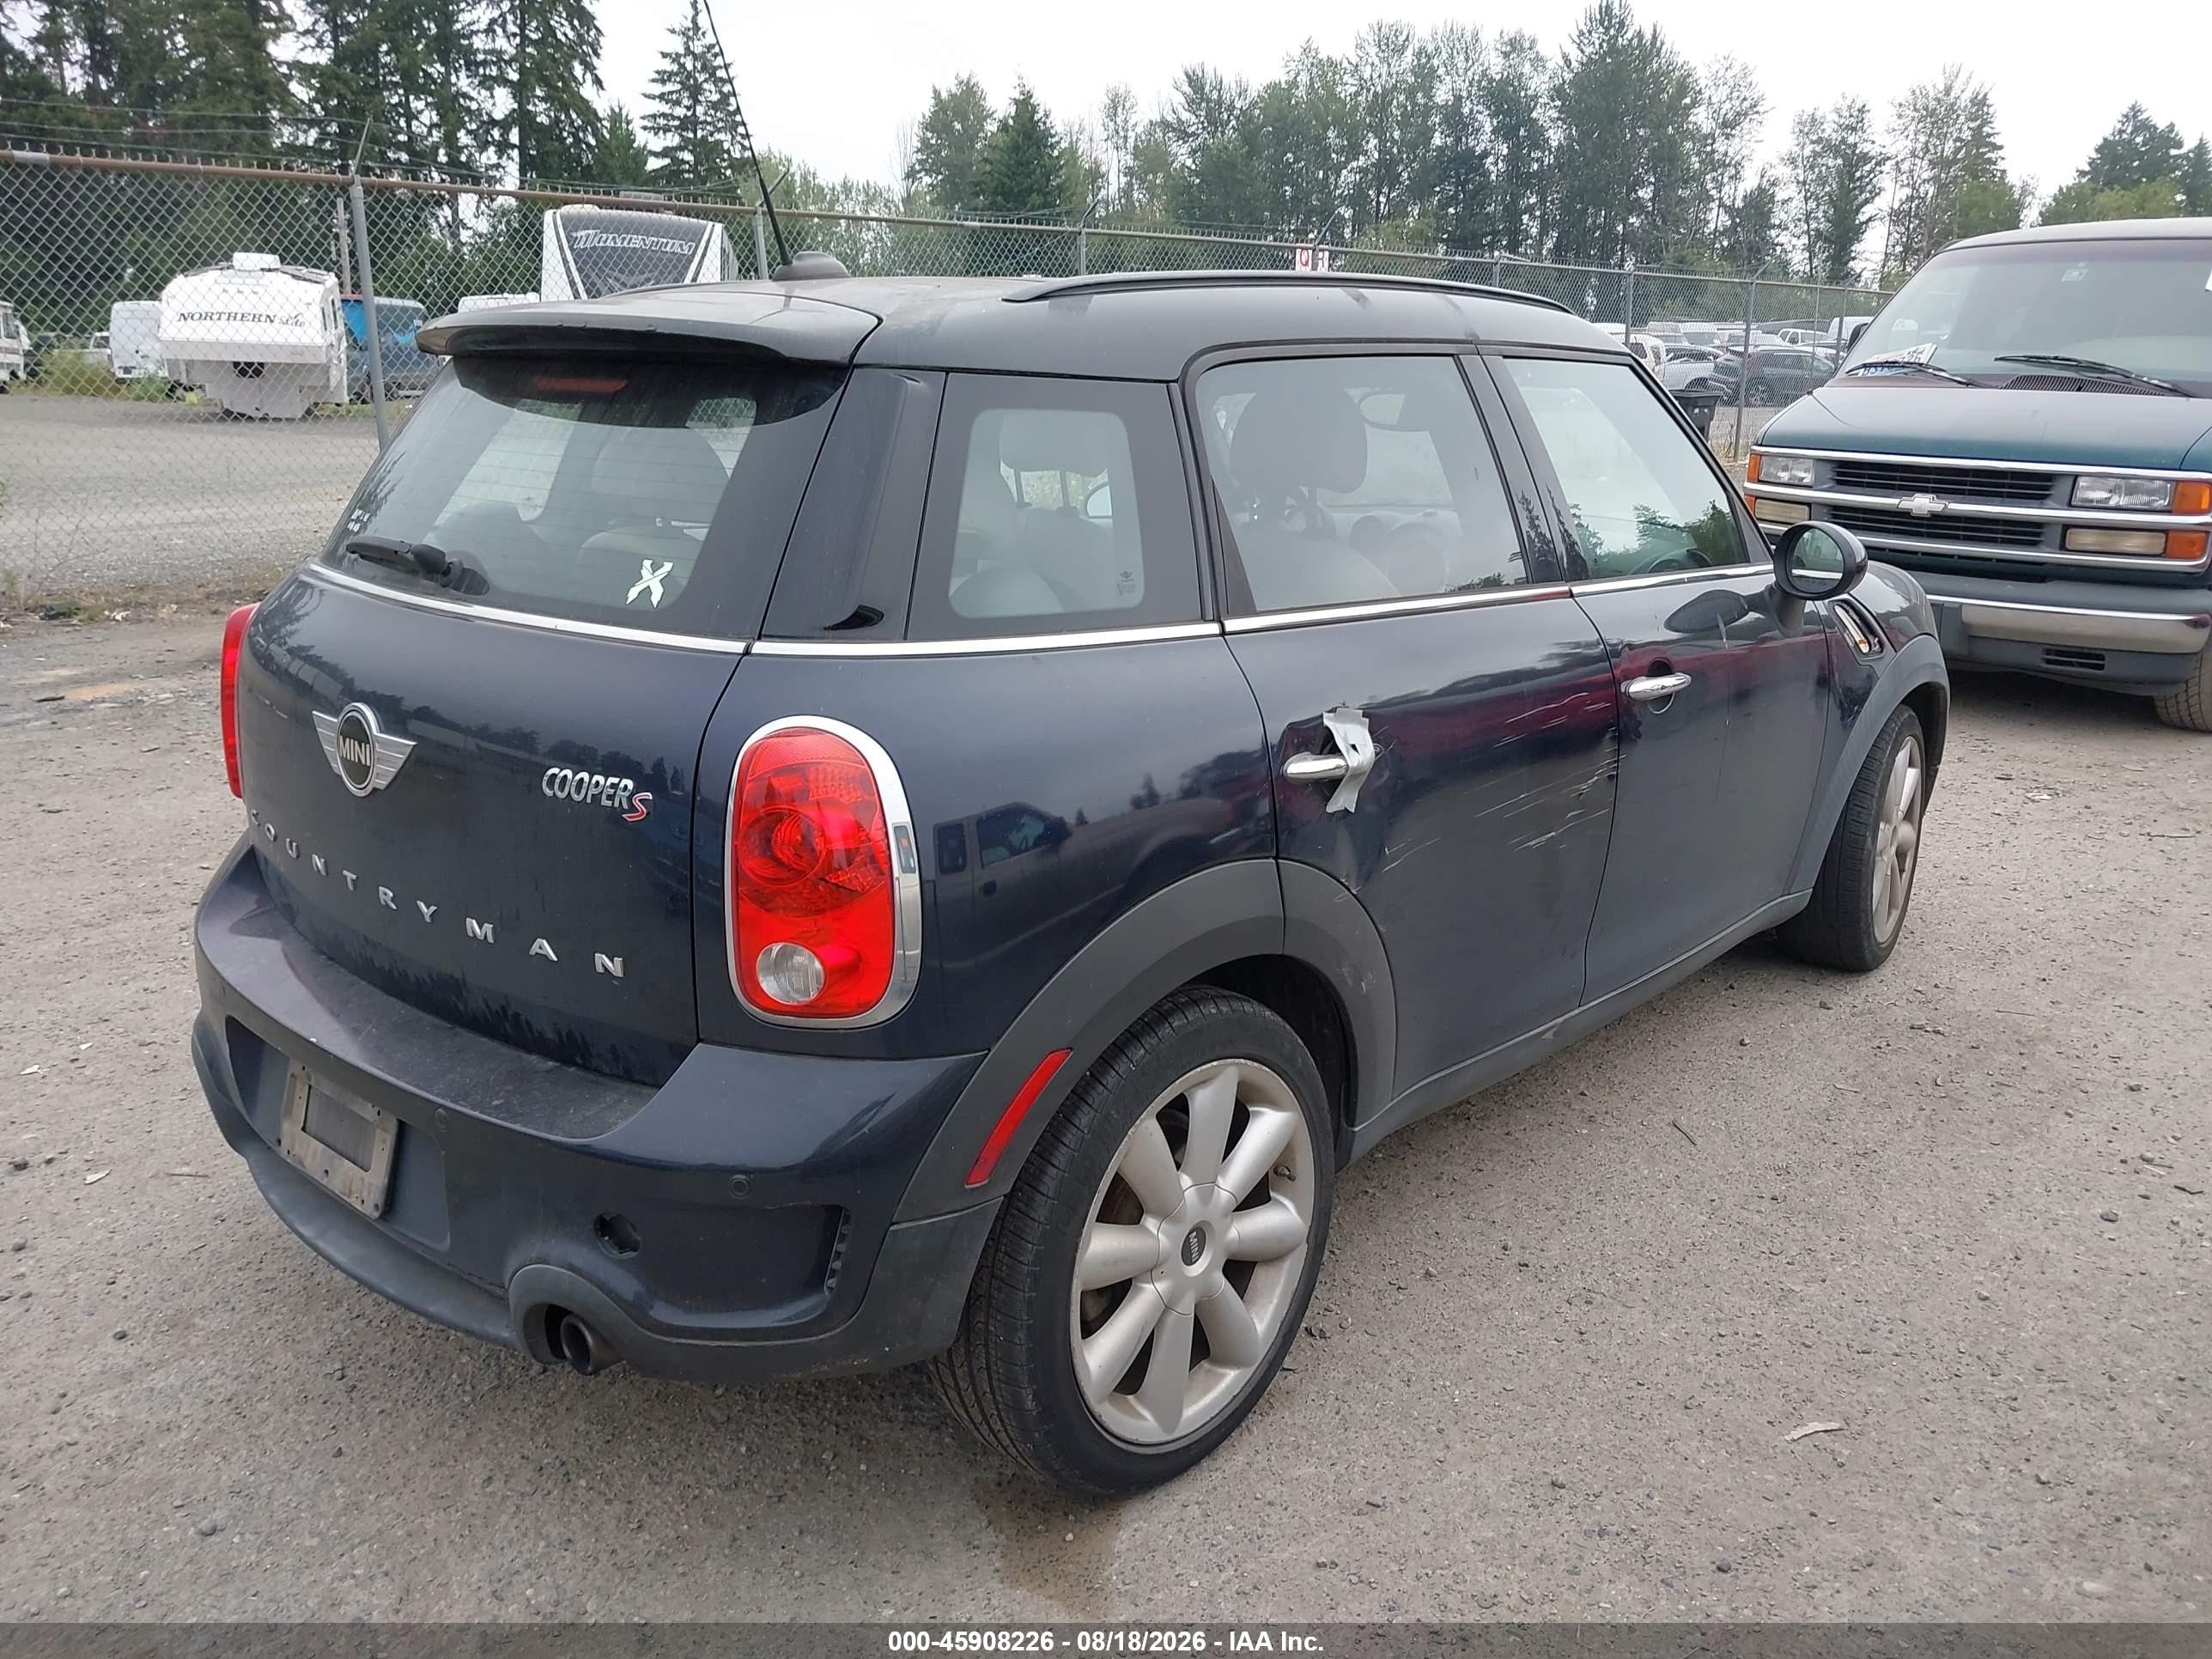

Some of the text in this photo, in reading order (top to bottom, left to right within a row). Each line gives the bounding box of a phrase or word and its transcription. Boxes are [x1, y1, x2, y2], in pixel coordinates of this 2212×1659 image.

[570, 228, 696, 255] MOMENTUM
[177, 311, 277, 324] NORTHERN
[338, 734, 372, 767] MINI
[541, 767, 635, 810] COOPER
[251, 809, 624, 979] COUNTRYMAN
[1188, 1230, 1200, 1263] MINI
